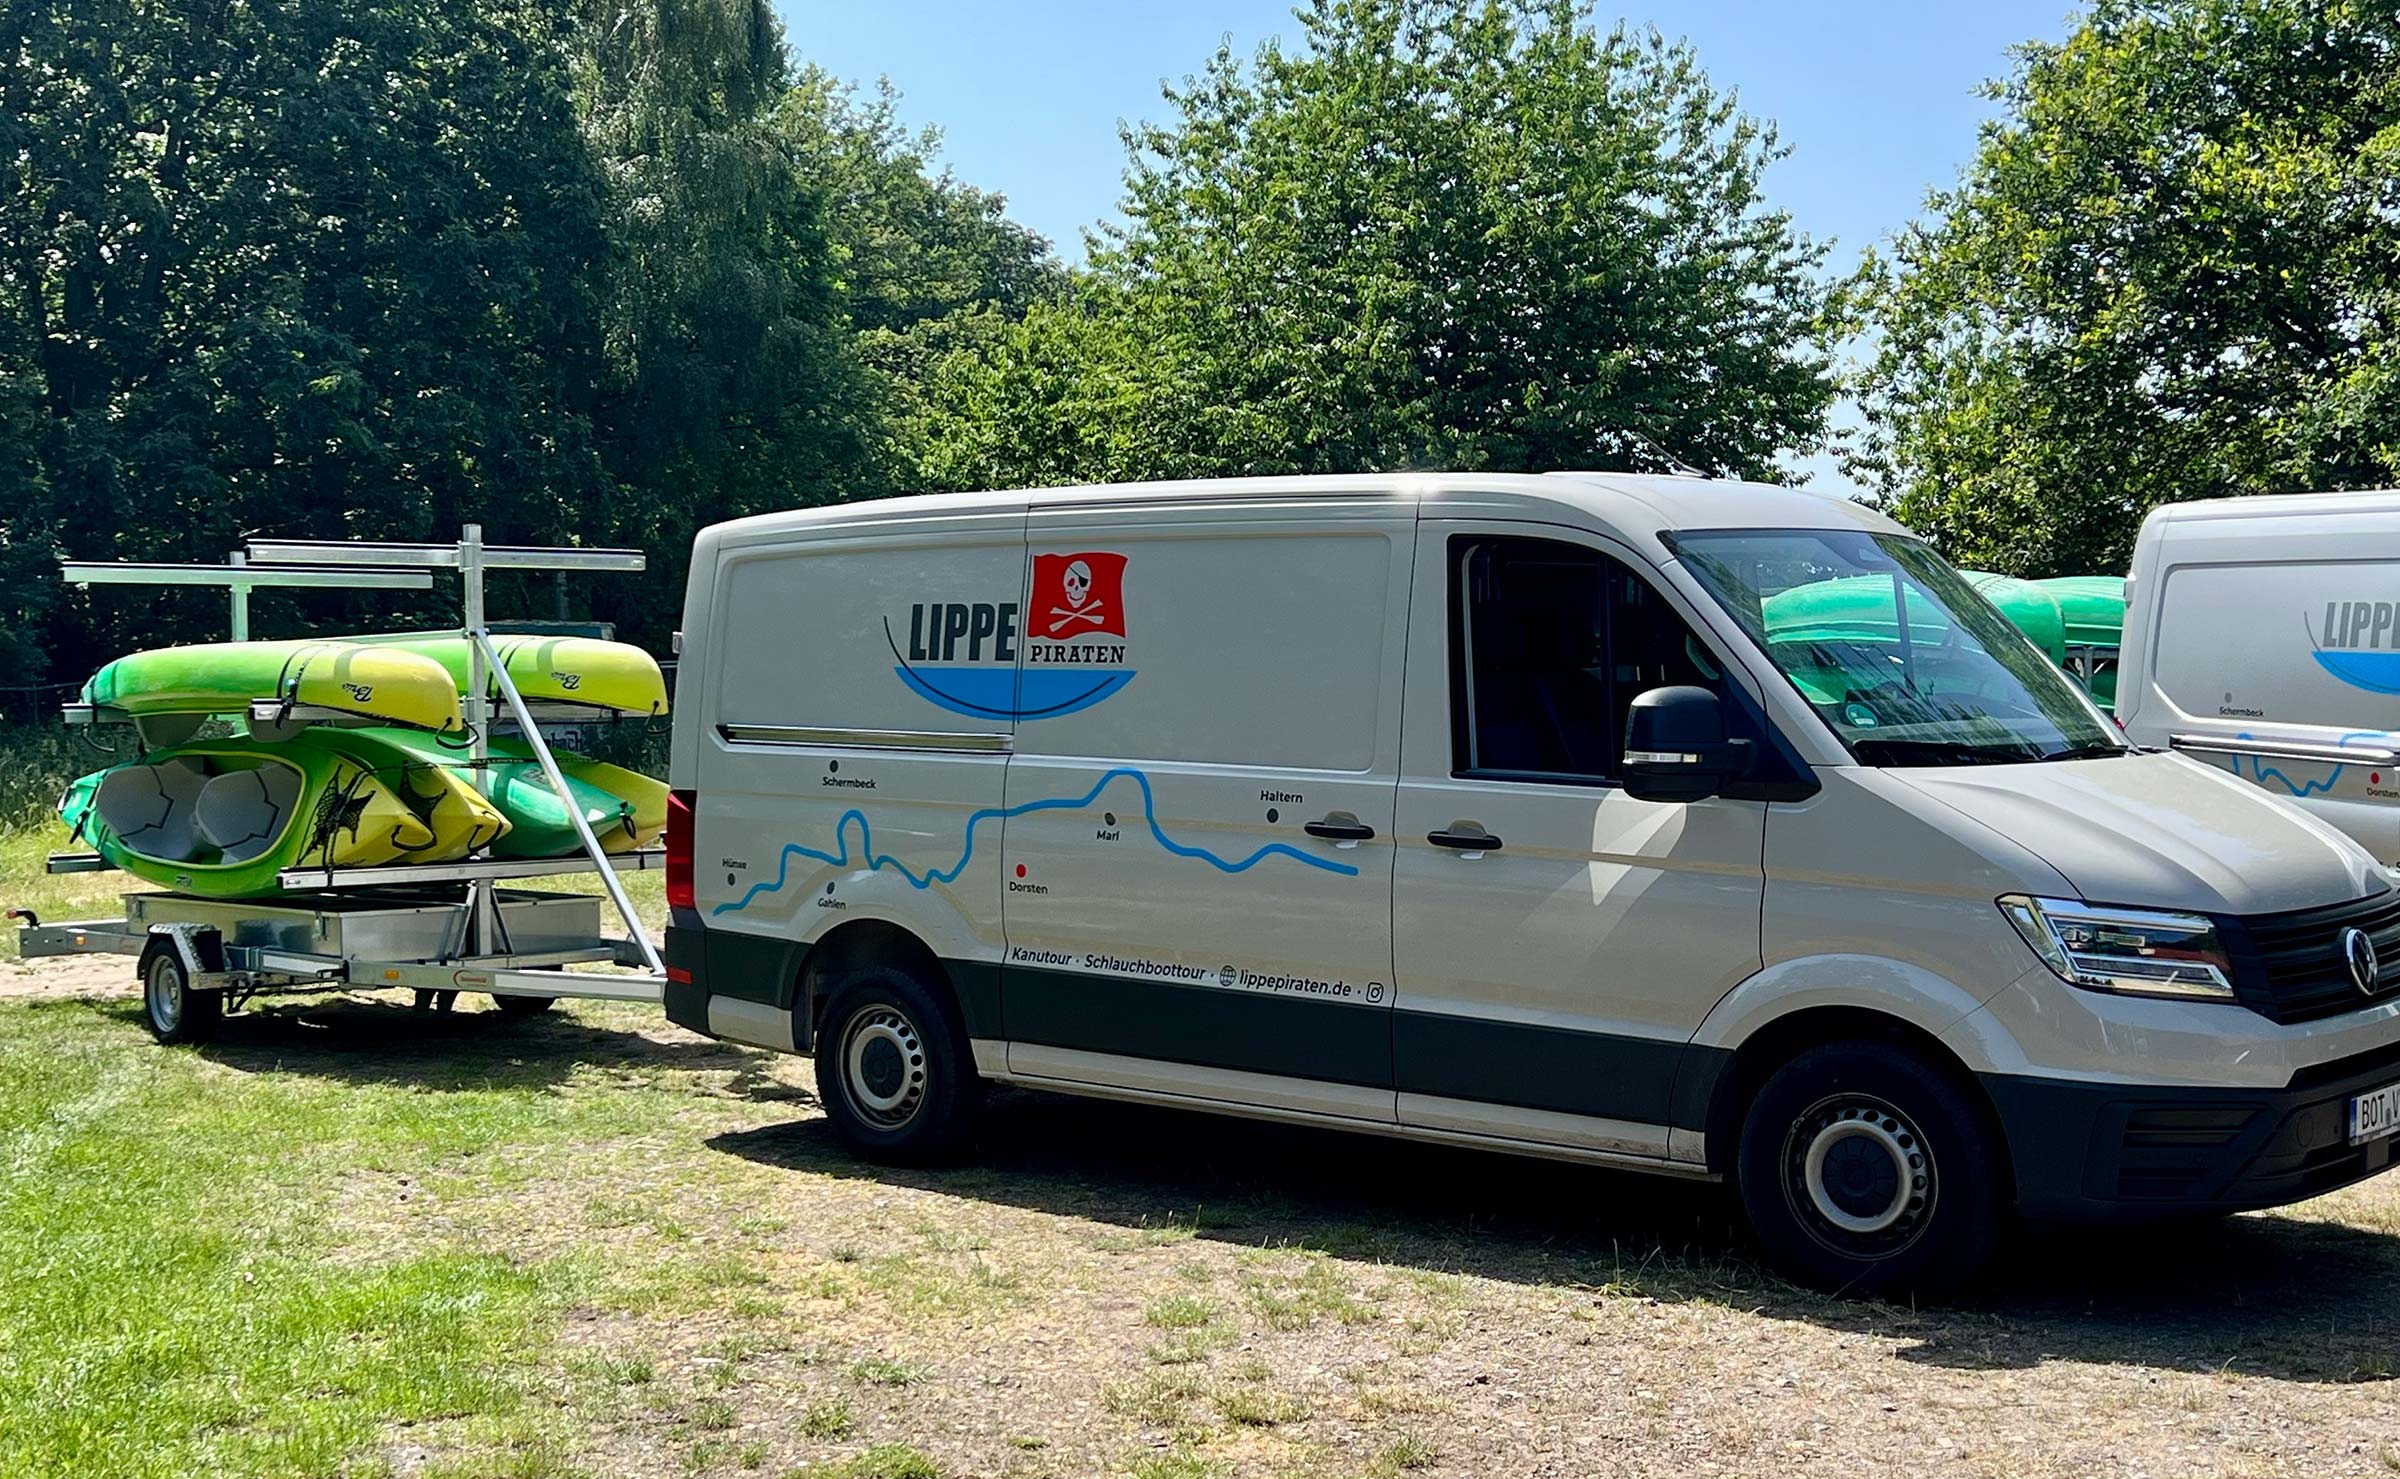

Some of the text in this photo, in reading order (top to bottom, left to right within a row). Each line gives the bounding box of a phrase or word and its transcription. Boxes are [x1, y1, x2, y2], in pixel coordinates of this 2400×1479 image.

[909, 603, 1018, 661] LIPPE
[1030, 645, 1126, 663] PIRATEN
[2219, 706, 2264, 717] Schermbeck
[822, 776, 877, 789] Schermbeck
[1260, 789, 1303, 804] Haltern
[2366, 787, 2400, 798] Dorsten
[1096, 830, 1120, 841] Marl
[1009, 881, 1048, 894] Dorsten
[817, 898, 847, 910] Gahlen
[1011, 947, 1352, 997] Kanutour Schlauchboottour lippepiraten.de
[2362, 1093, 2385, 1130] BOT
